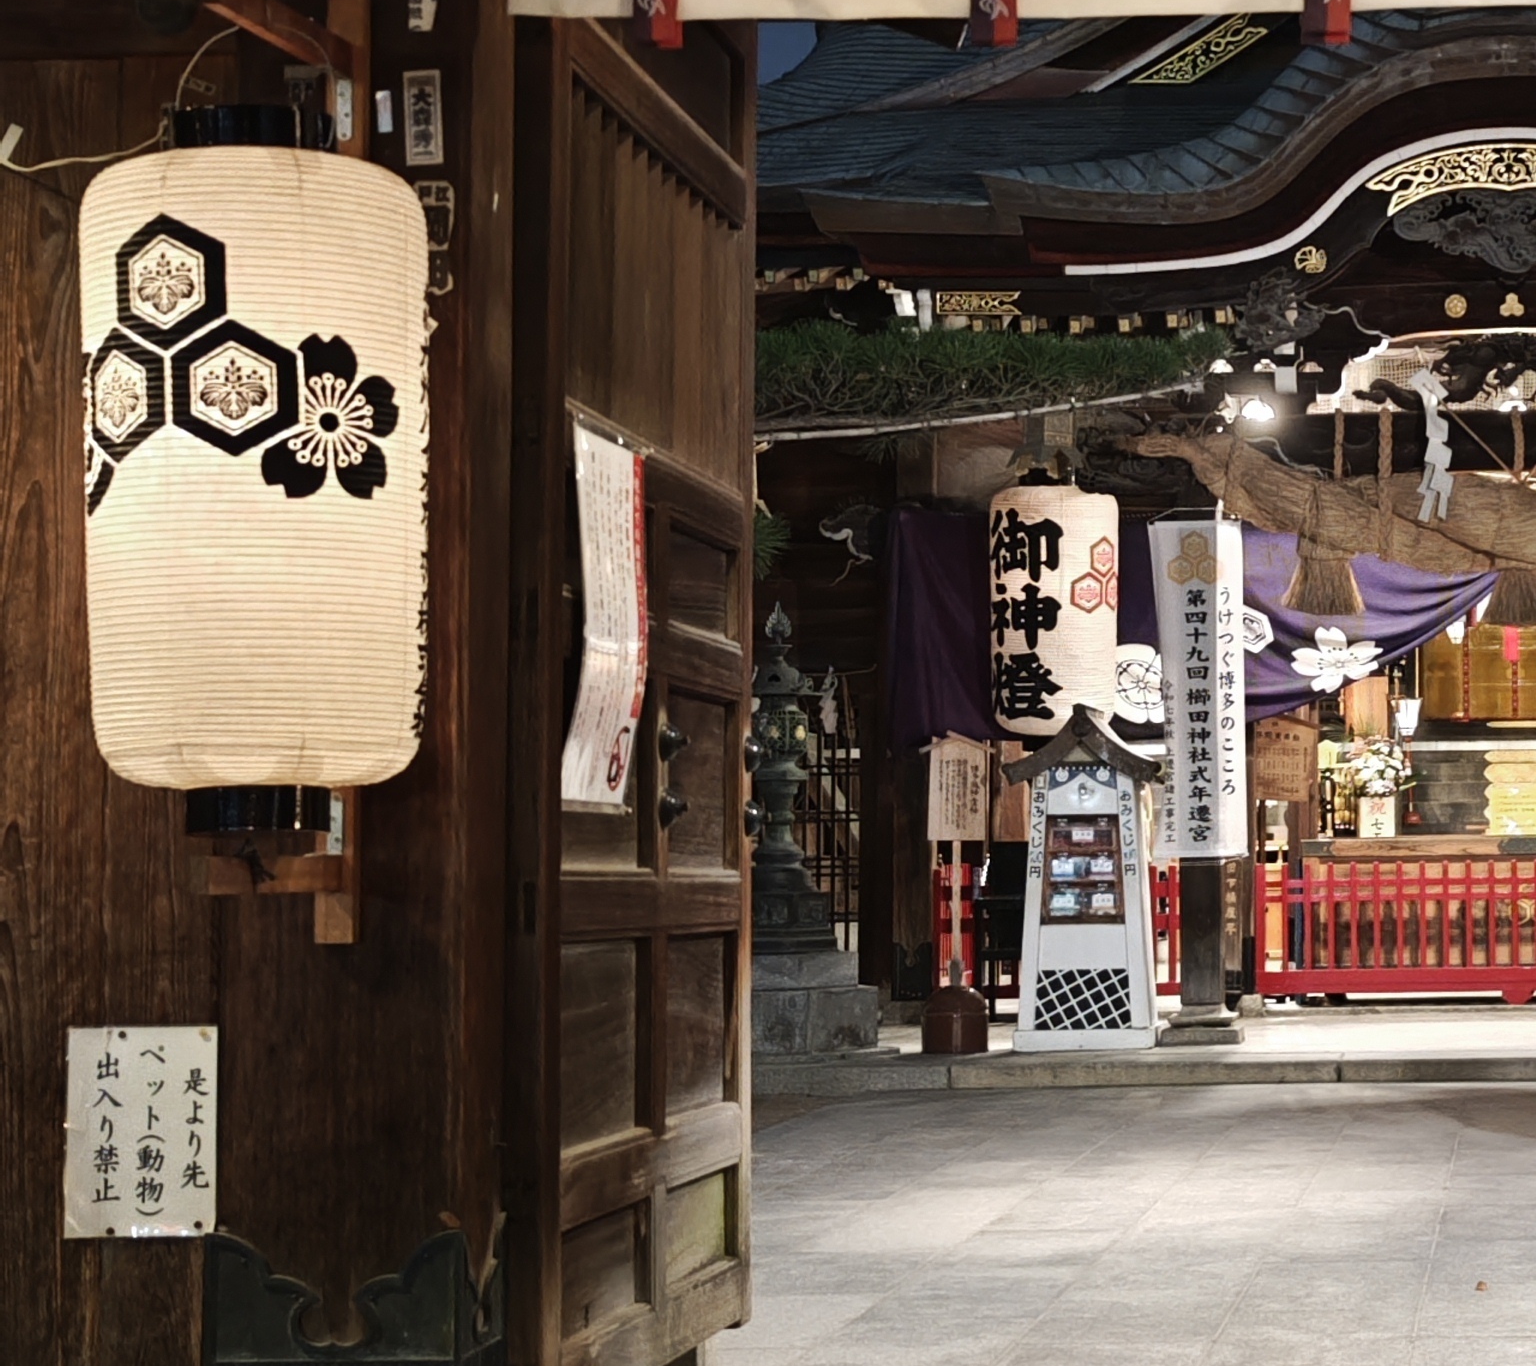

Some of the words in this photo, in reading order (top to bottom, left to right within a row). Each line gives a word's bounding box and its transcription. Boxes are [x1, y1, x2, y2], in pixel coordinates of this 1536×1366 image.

[990, 508, 1064, 721] 御神燈
[1218, 586, 1237, 795] うけつぐ博多のこころ
[91, 1051, 123, 1204] 出入り禁止
[134, 1045, 166, 1217] ペット（動物）
[180, 1067, 210, 1190] 是より先
